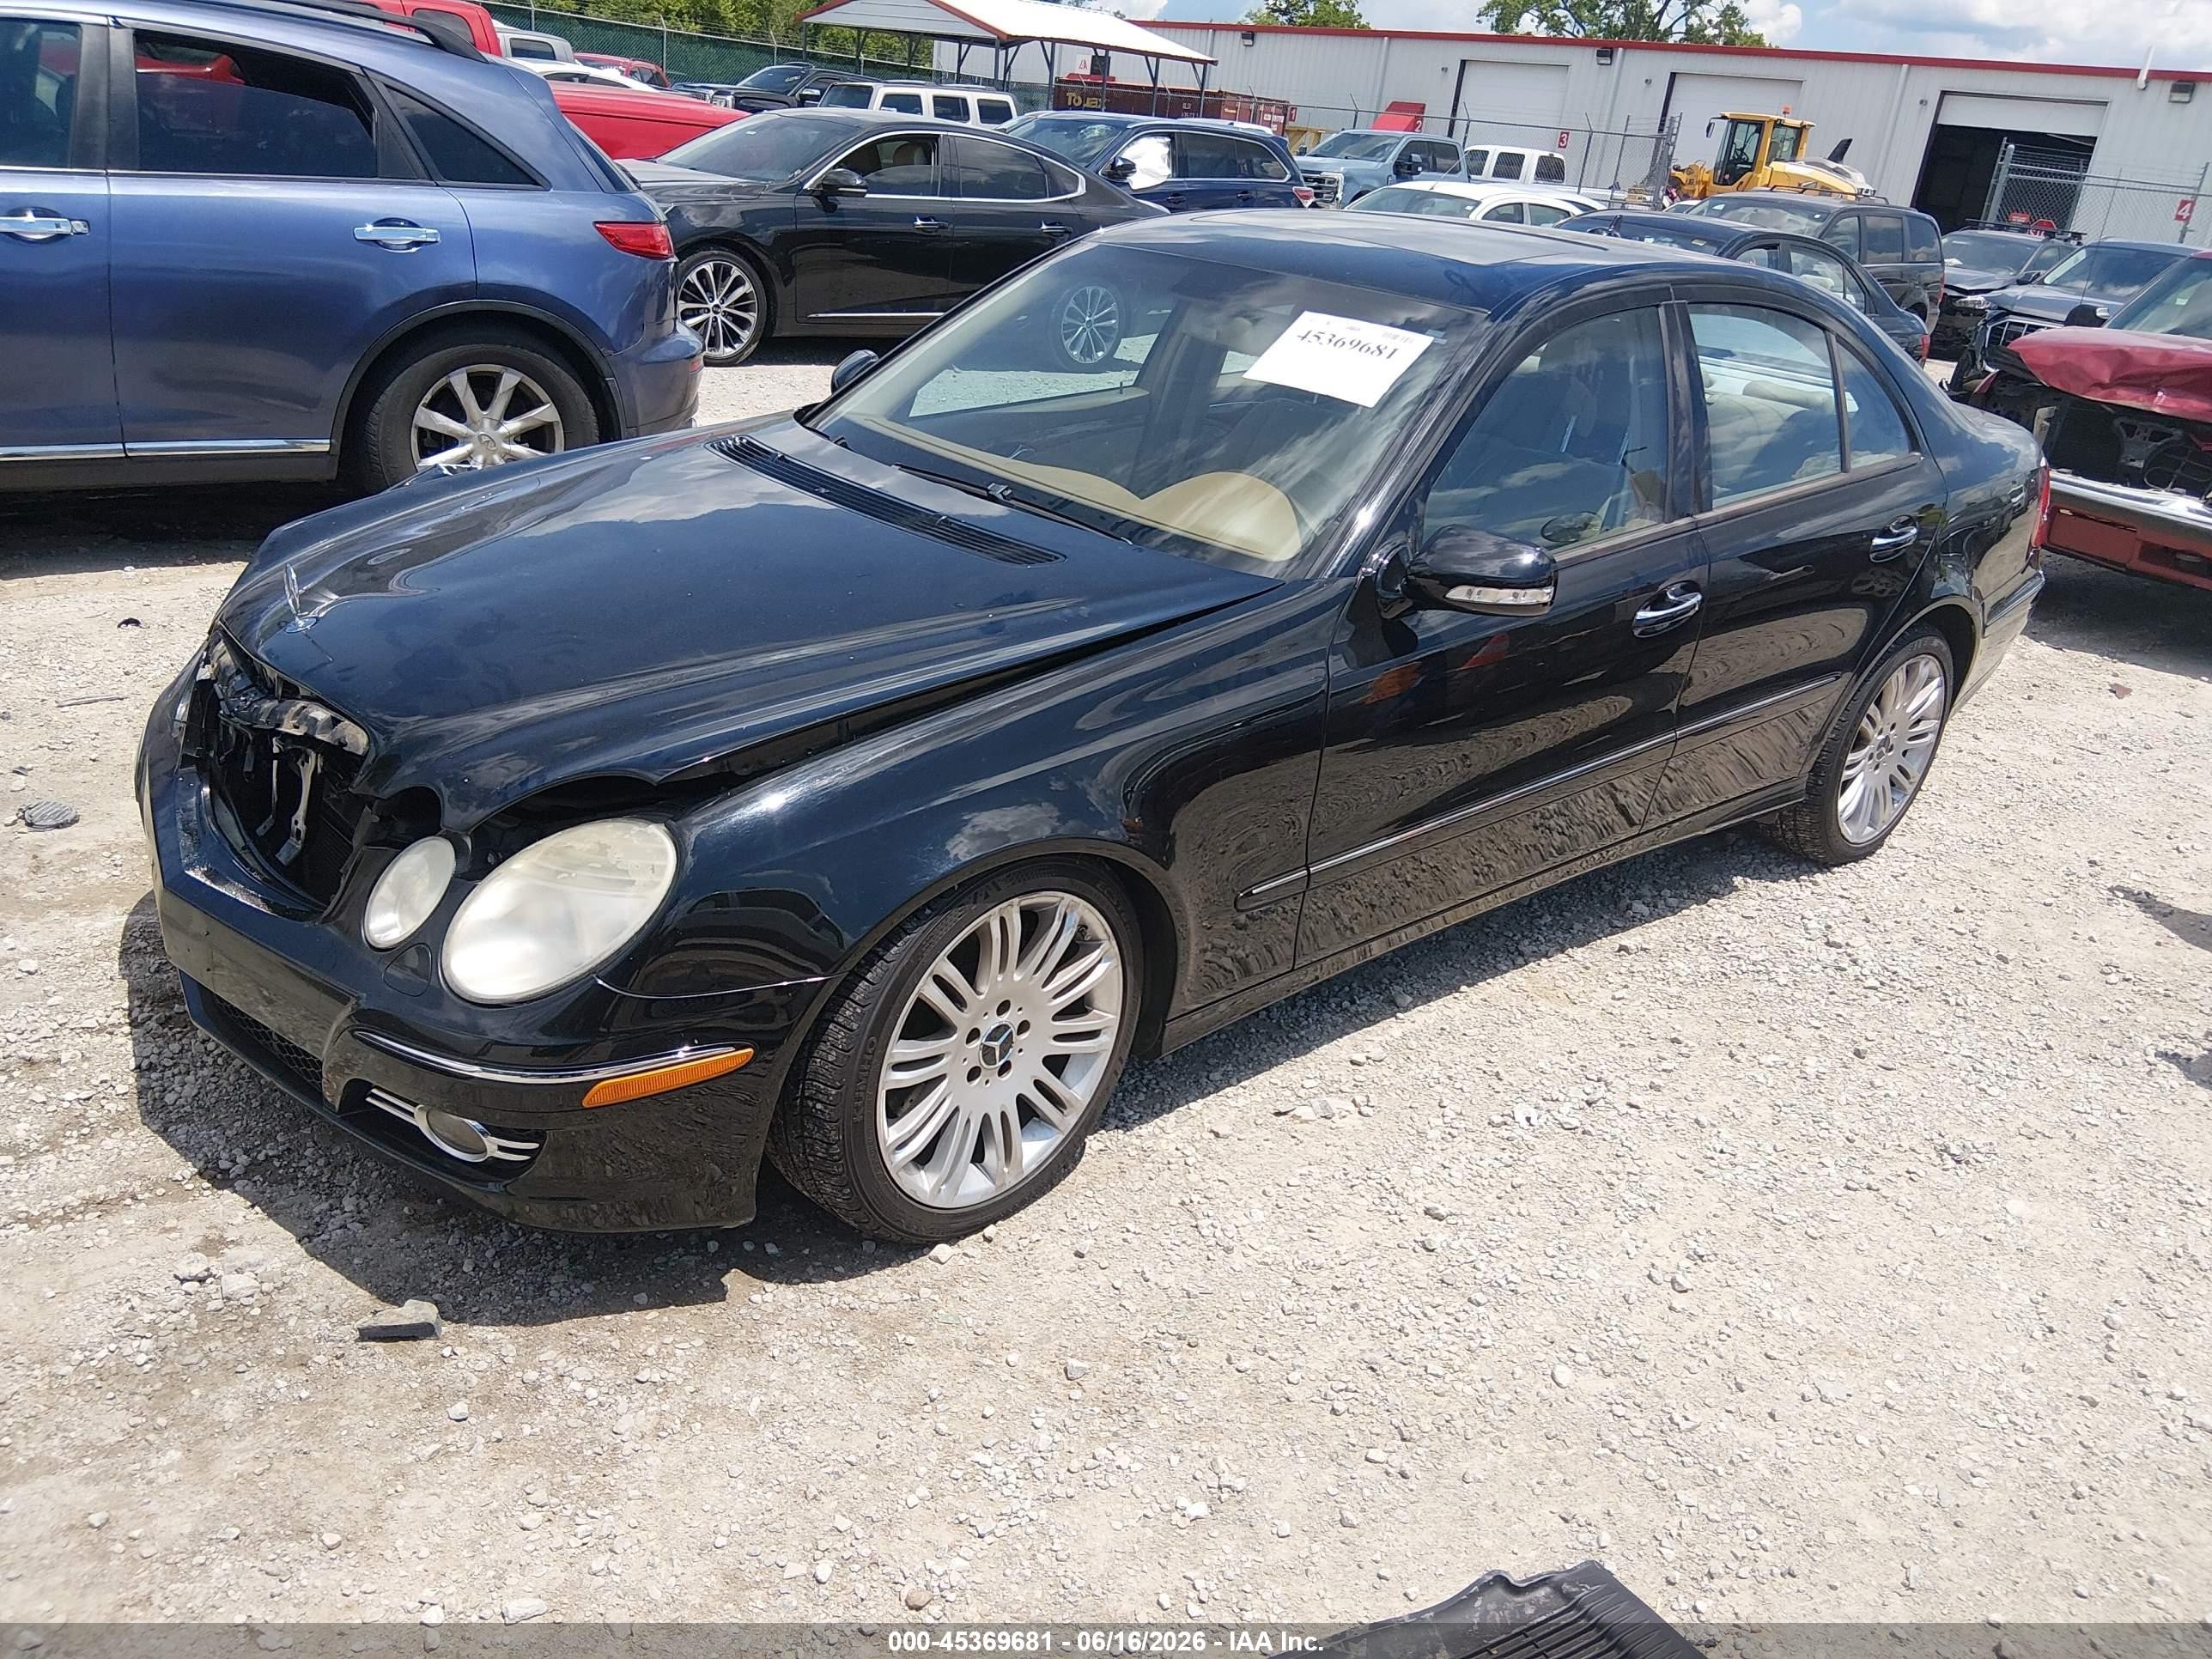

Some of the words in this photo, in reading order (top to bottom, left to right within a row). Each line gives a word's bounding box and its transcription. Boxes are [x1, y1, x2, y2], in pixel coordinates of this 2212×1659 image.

[1414, 119, 1422, 131] 2
[1559, 133, 1567, 146] 3
[2177, 202, 2192, 220] 4
[1297, 330, 1399, 359] 45369681
